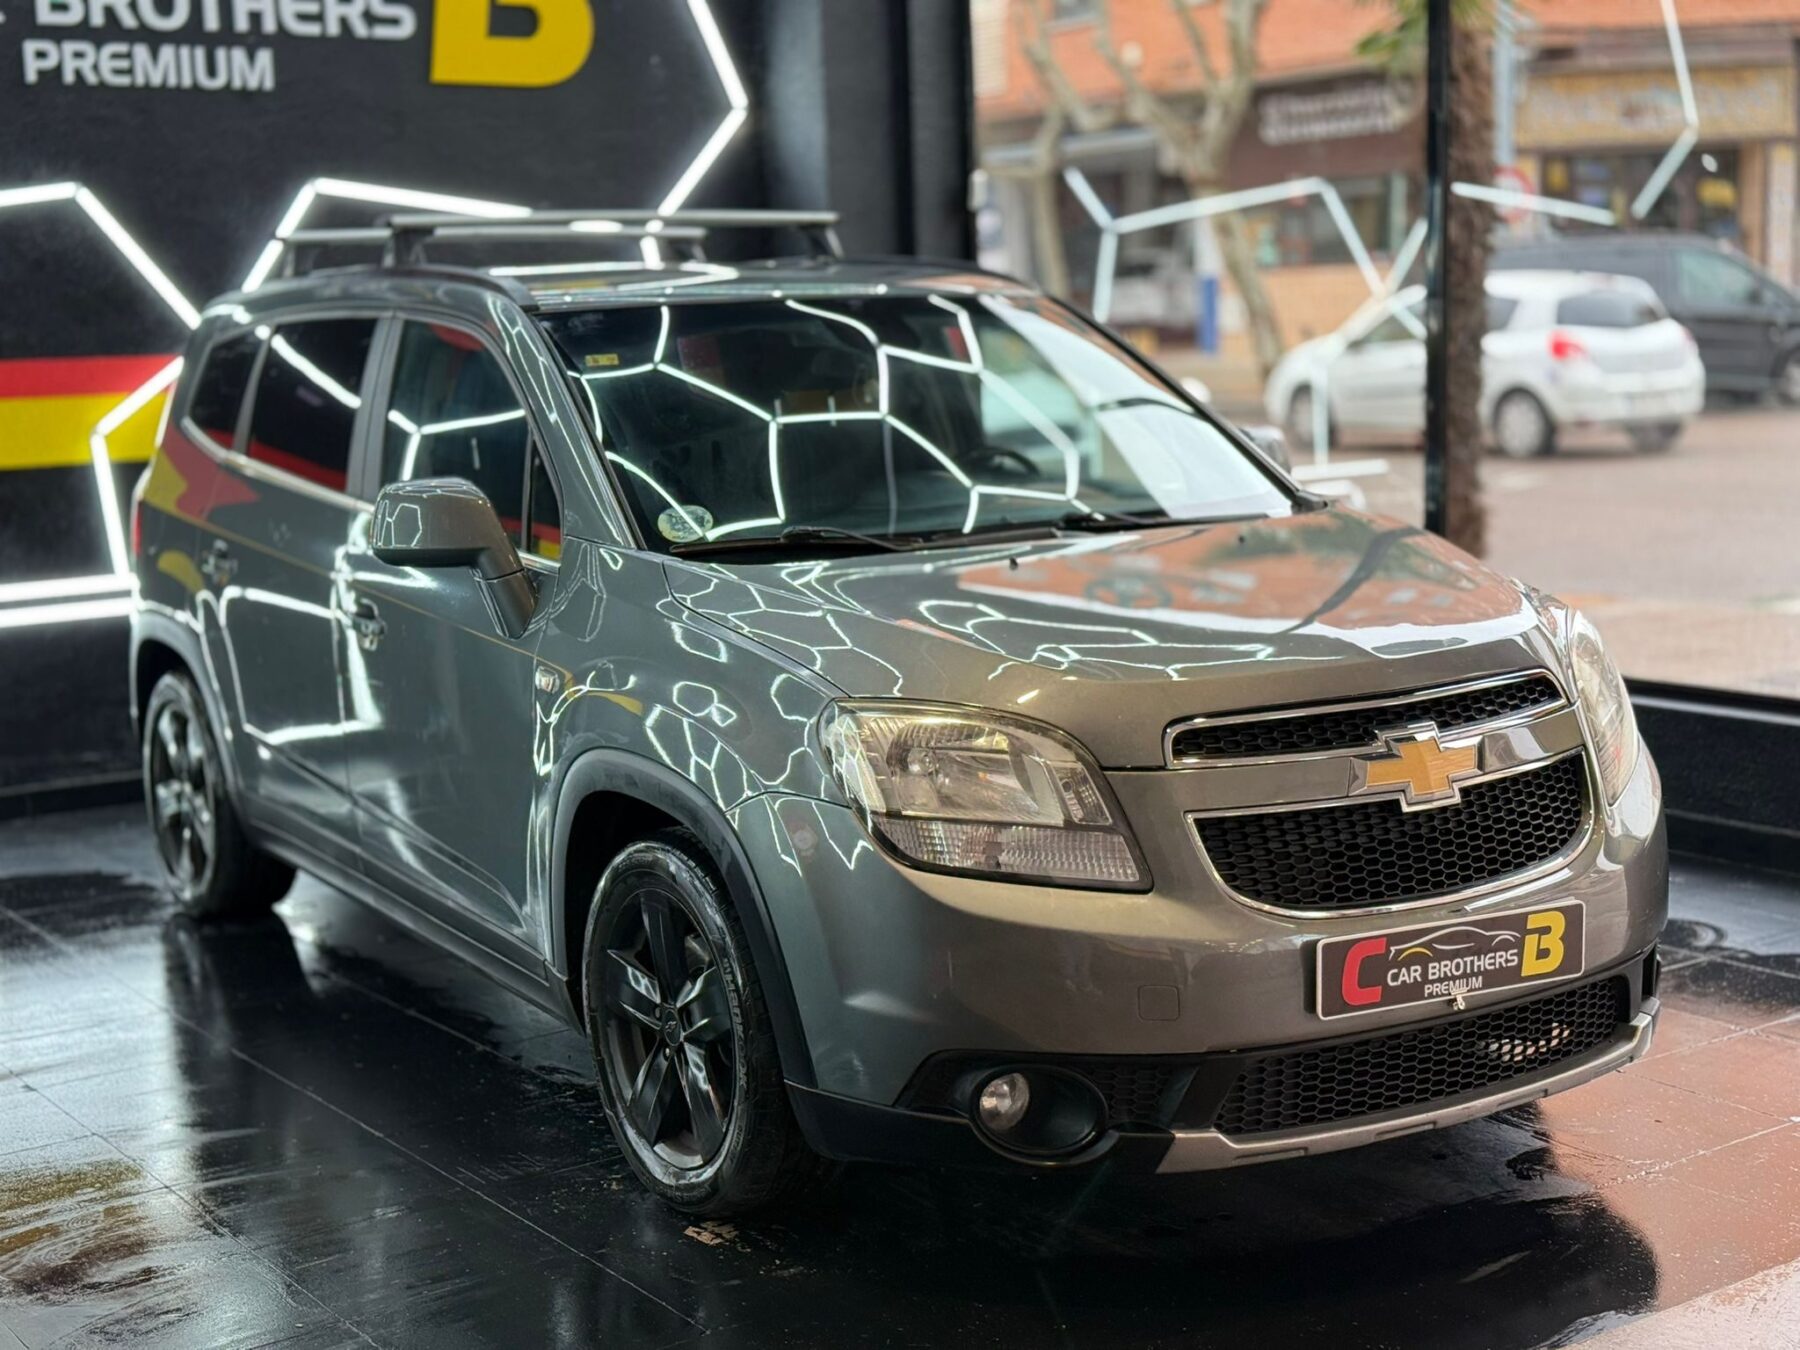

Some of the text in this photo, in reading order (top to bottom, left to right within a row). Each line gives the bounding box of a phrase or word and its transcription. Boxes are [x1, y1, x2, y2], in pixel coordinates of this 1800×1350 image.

[22, 39, 275, 91] PREMIUM
[1386, 949, 1518, 987] CAR BROTHERS
[1521, 911, 1566, 977] B
[1342, 937, 1387, 1006] C
[1424, 976, 1483, 998] PREMIUM
